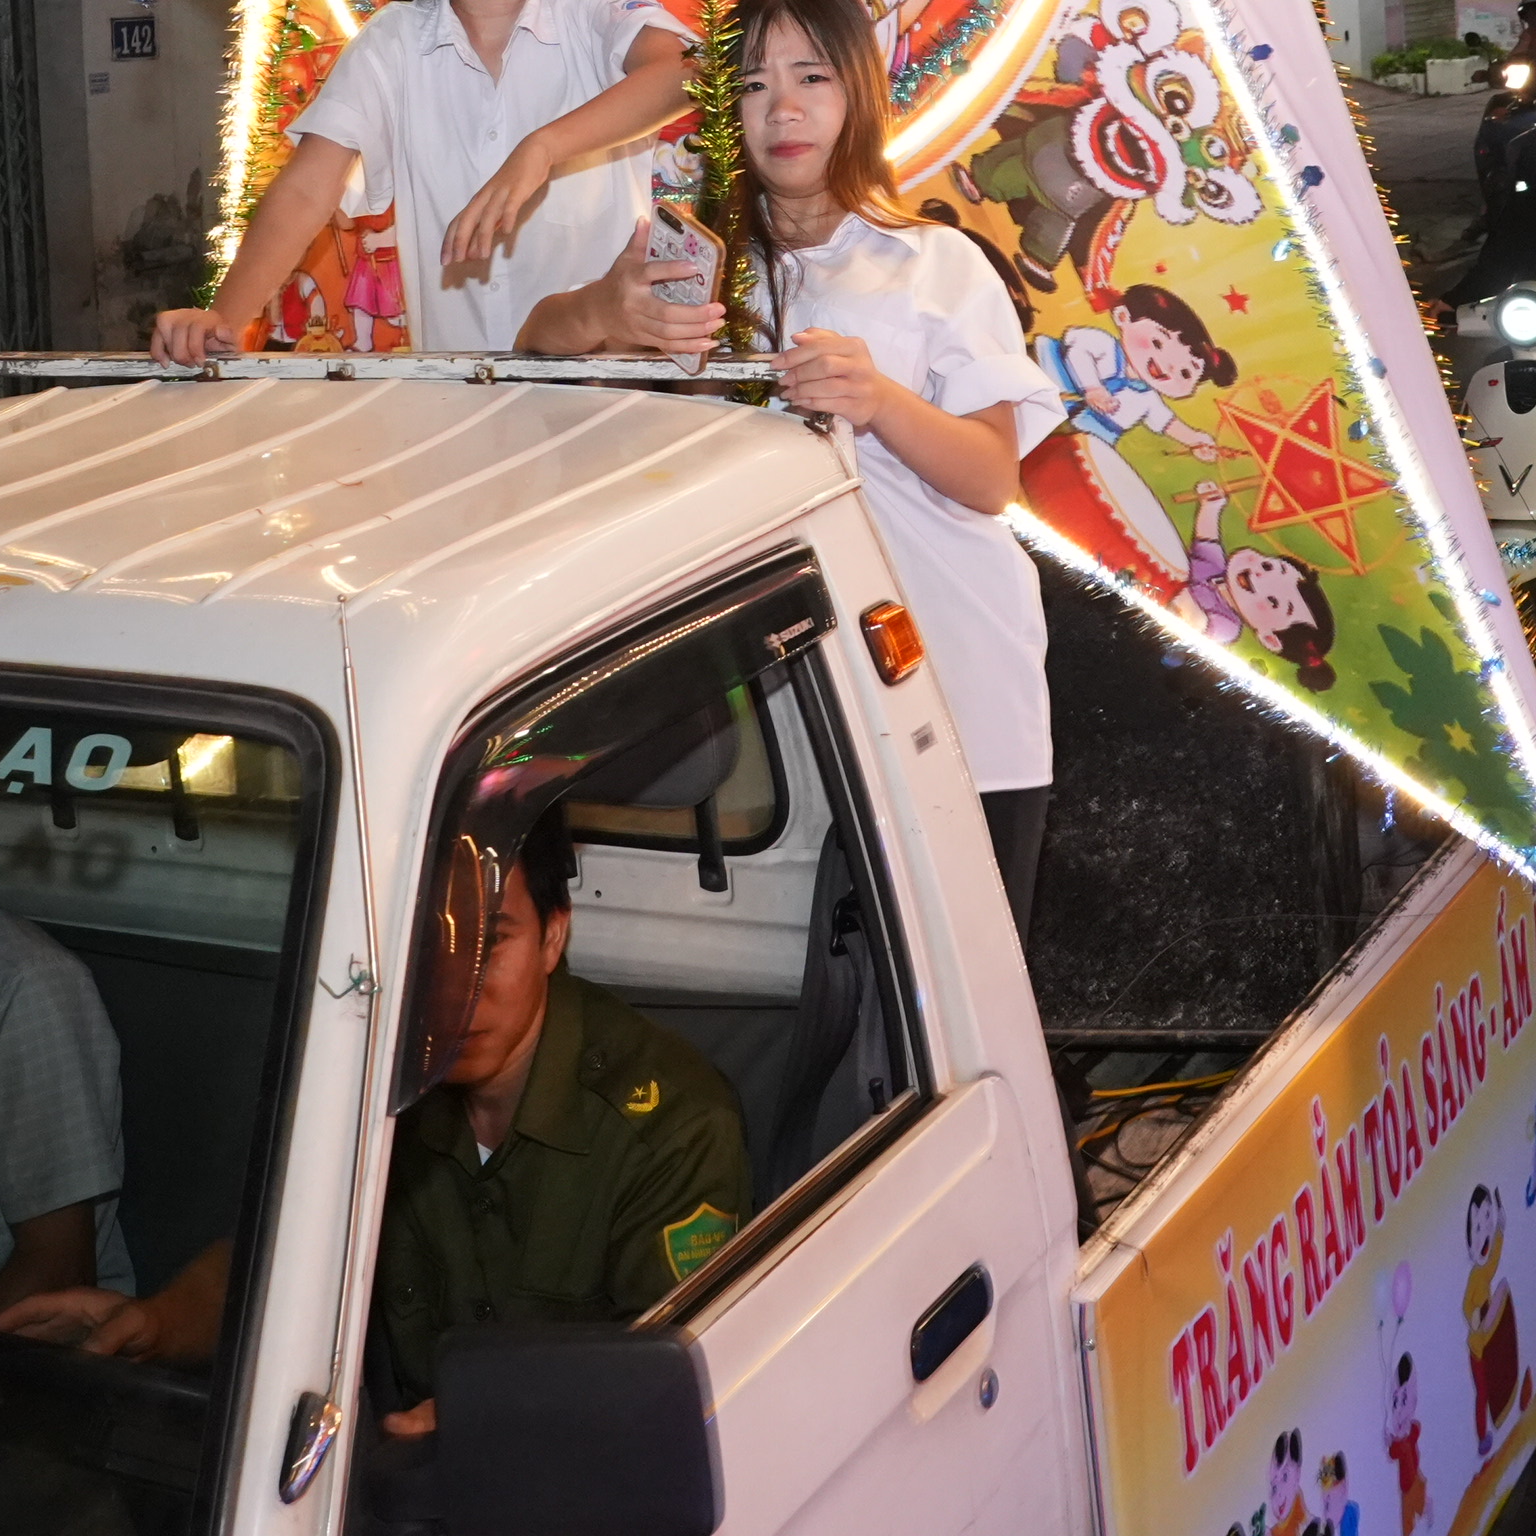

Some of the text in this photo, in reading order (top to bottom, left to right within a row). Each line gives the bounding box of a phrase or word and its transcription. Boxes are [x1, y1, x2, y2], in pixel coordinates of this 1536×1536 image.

[120, 25, 154, 54] 142
[1171, 1214, 1294, 1474] TRĂNG
[1294, 1097, 1366, 1319] RẰM
[1421, 972, 1487, 1147] SÁNG
[1497, 888, 1532, 1050] ẤM
